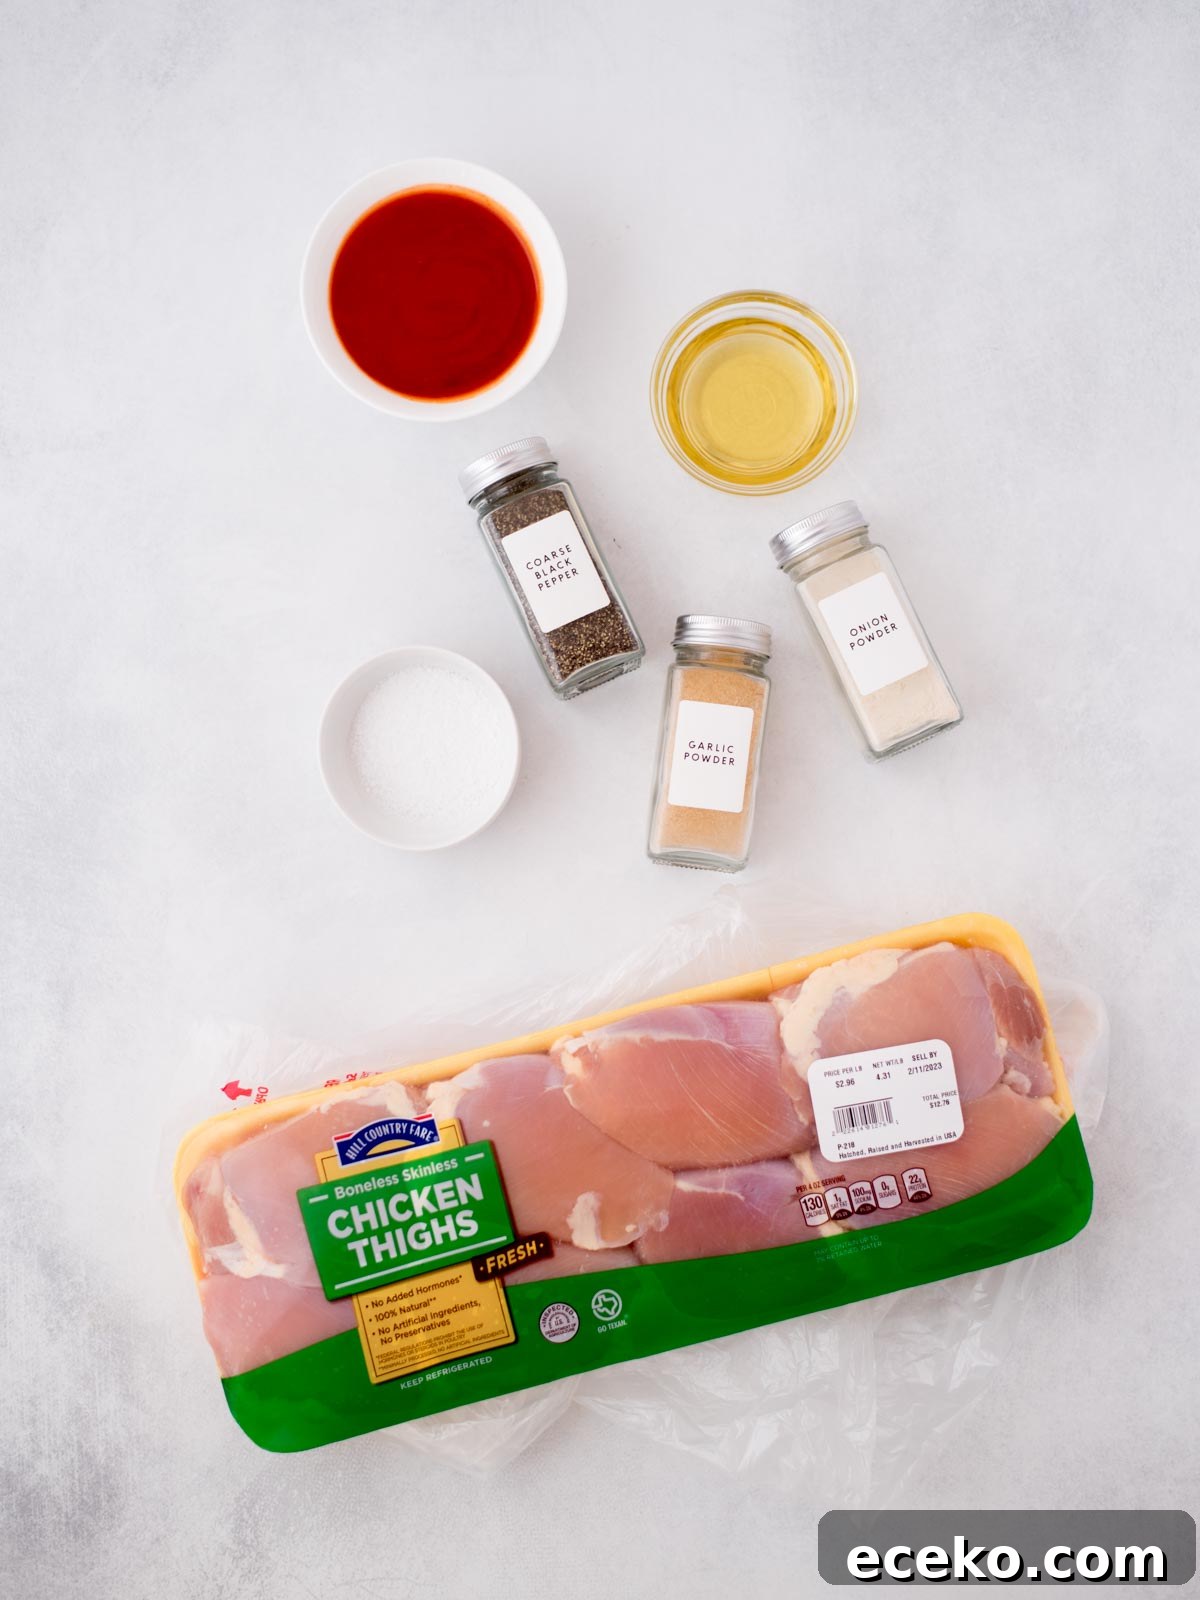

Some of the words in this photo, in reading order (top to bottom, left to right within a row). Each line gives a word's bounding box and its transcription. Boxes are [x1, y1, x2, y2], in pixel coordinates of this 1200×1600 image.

[526, 544, 572, 570] COARSE
[534, 557, 572, 580] BLACK
[537, 568, 579, 591] PEPPER
[849, 613, 889, 637] ONION
[849, 622, 898, 650] POWDER
[688, 740, 734, 754] GARLIC
[683, 752, 735, 766] POWDER
[872, 1061, 884, 1069] NET
[911, 1054, 928, 1062] SELL
[823, 1070, 841, 1078] PRICE
[841, 1067, 854, 1075] PER
[876, 1071, 891, 1081] 4.31
[907, 1062, 943, 1076] 2/11/2023
[835, 1078, 856, 1088] $2.96
[922, 1094, 940, 1102] TOTAL
[941, 1090, 958, 1098] PRICE
[345, 1138, 367, 1160] HILL
[364, 1122, 408, 1142] COUNTRY
[839, 1150, 867, 1160] Hatched,
[868, 1145, 889, 1154] Raised
[891, 1140, 903, 1150] and
[904, 1136, 935, 1147] Harvested
[944, 1131, 957, 1140] USA
[334, 1174, 399, 1200] Boneless
[402, 1158, 458, 1181] Skinless
[795, 1185, 808, 1194] PER
[813, 1181, 821, 1189] OZ
[820, 1174, 846, 1187] SERVING
[327, 1173, 484, 1239] CHICKEN
[802, 1195, 823, 1212] 130
[347, 1210, 479, 1268] THIGHS
[486, 1240, 538, 1274] FRESH
[371, 1300, 384, 1309] No
[386, 1290, 414, 1305] Added
[374, 1308, 398, 1322] 100%
[378, 1327, 391, 1336] No
[393, 1313, 428, 1331] Artificial
[430, 1299, 481, 1317] Ingredients,
[380, 1336, 393, 1345] No
[394, 1318, 451, 1341] Preservatives
[597, 1325, 607, 1333] GO
[400, 1376, 424, 1390] KEEP
[425, 1355, 493, 1382] REFRIGERATED
